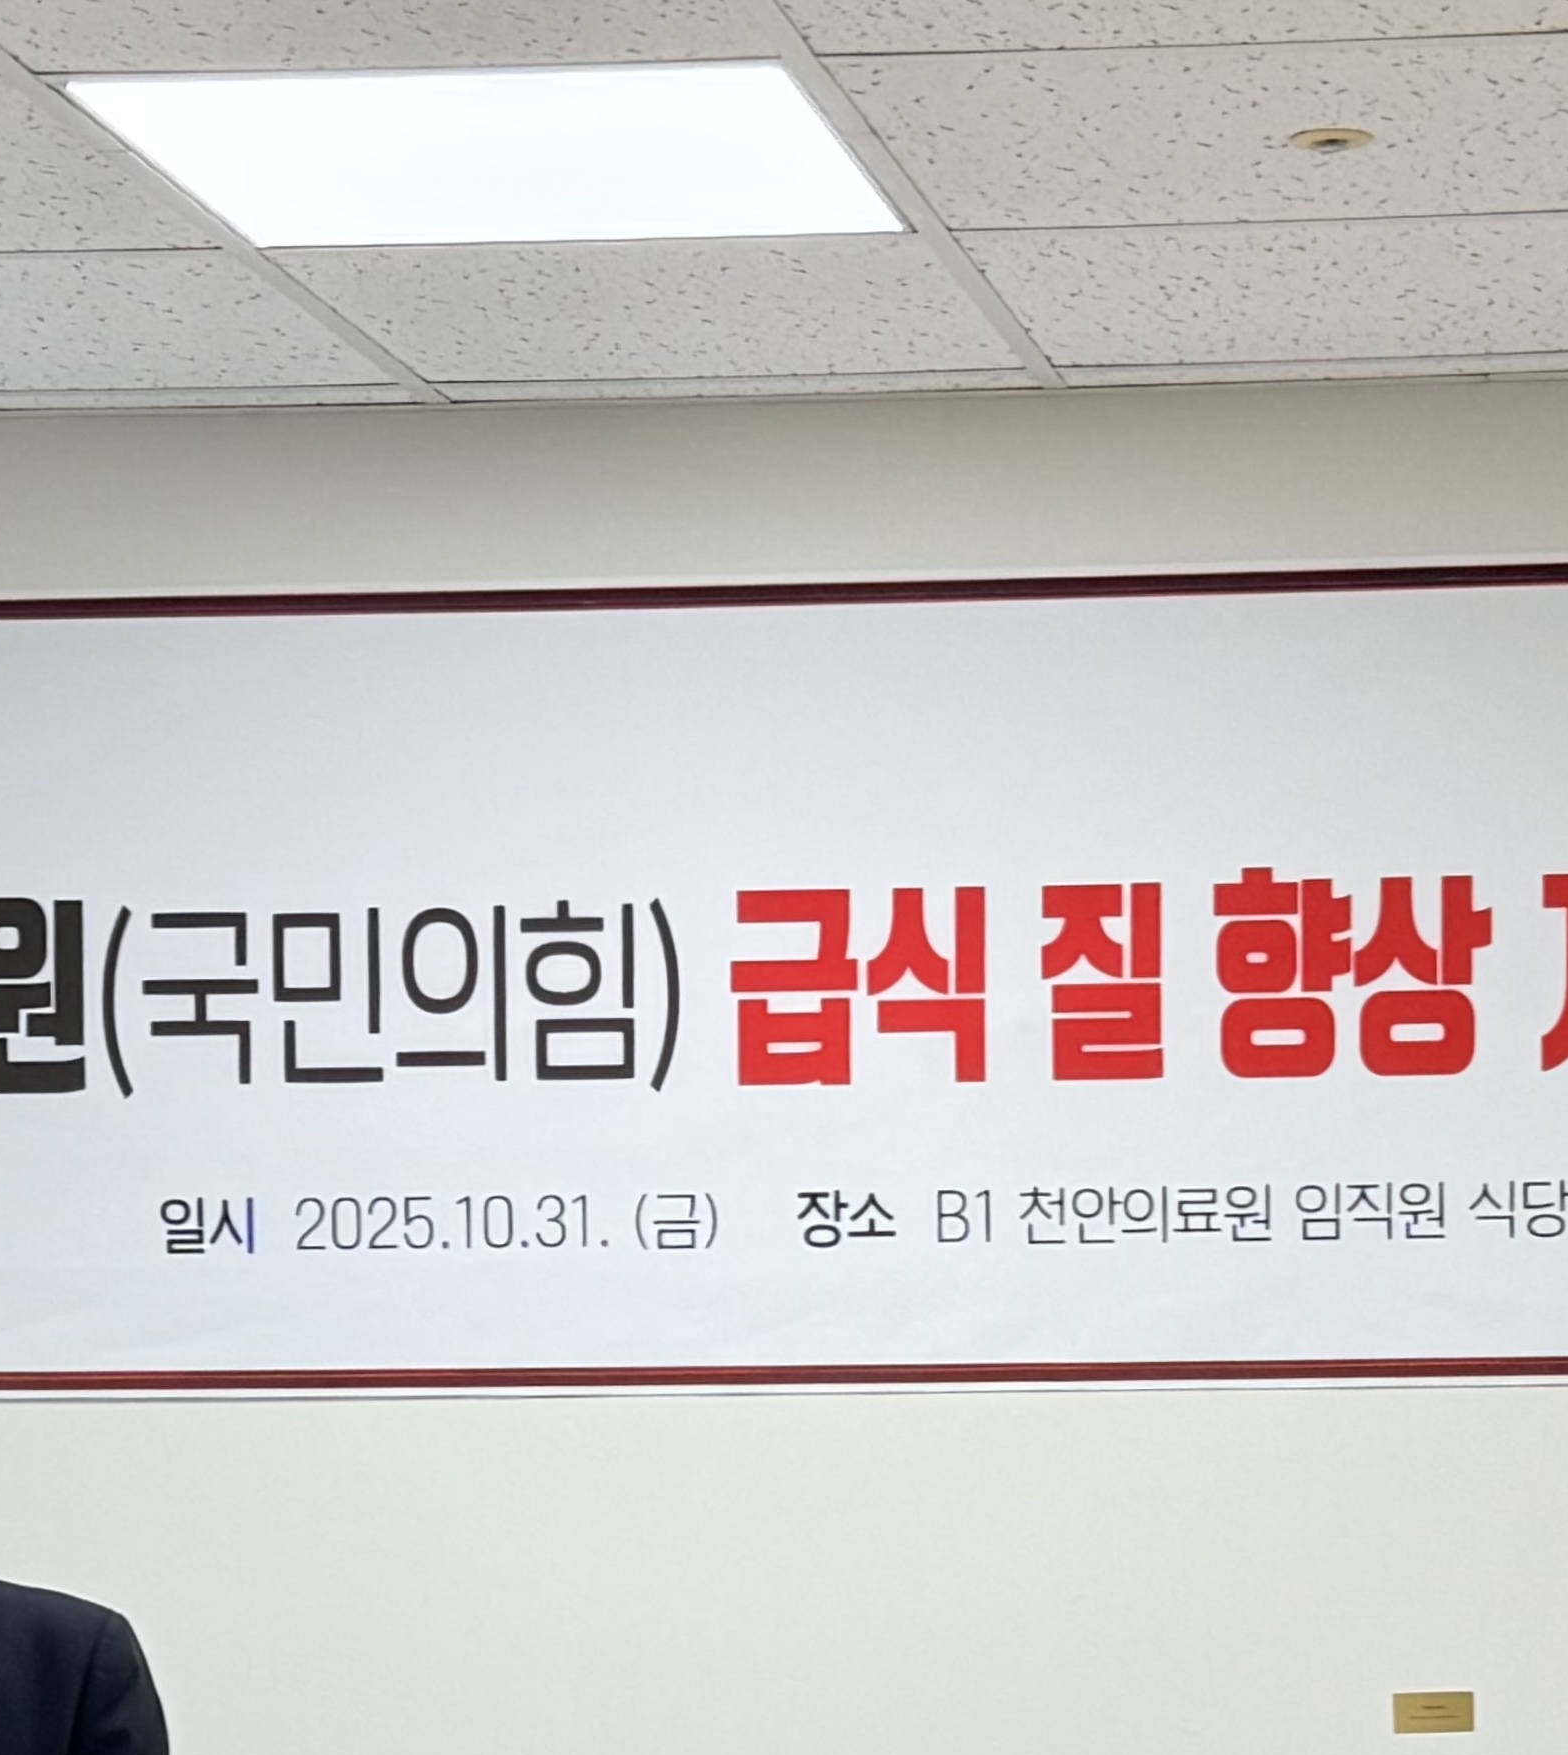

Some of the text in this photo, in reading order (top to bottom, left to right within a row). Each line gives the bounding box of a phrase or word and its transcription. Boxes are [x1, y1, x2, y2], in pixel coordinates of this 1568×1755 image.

[730, 886, 987, 1087] 급식
[1041, 882, 1166, 1082] 질
[1213, 867, 1494, 1079] 향상
[160, 1197, 256, 1255] 일시
[296, 1195, 610, 1251] 2025.10.31.
[636, 1193, 719, 1251] (금)
[797, 1190, 898, 1249] 장소
[937, 1190, 993, 1245] B1
[1020, 1184, 1274, 1246] 천안의료원
[1296, 1182, 1447, 1242] 임직원
